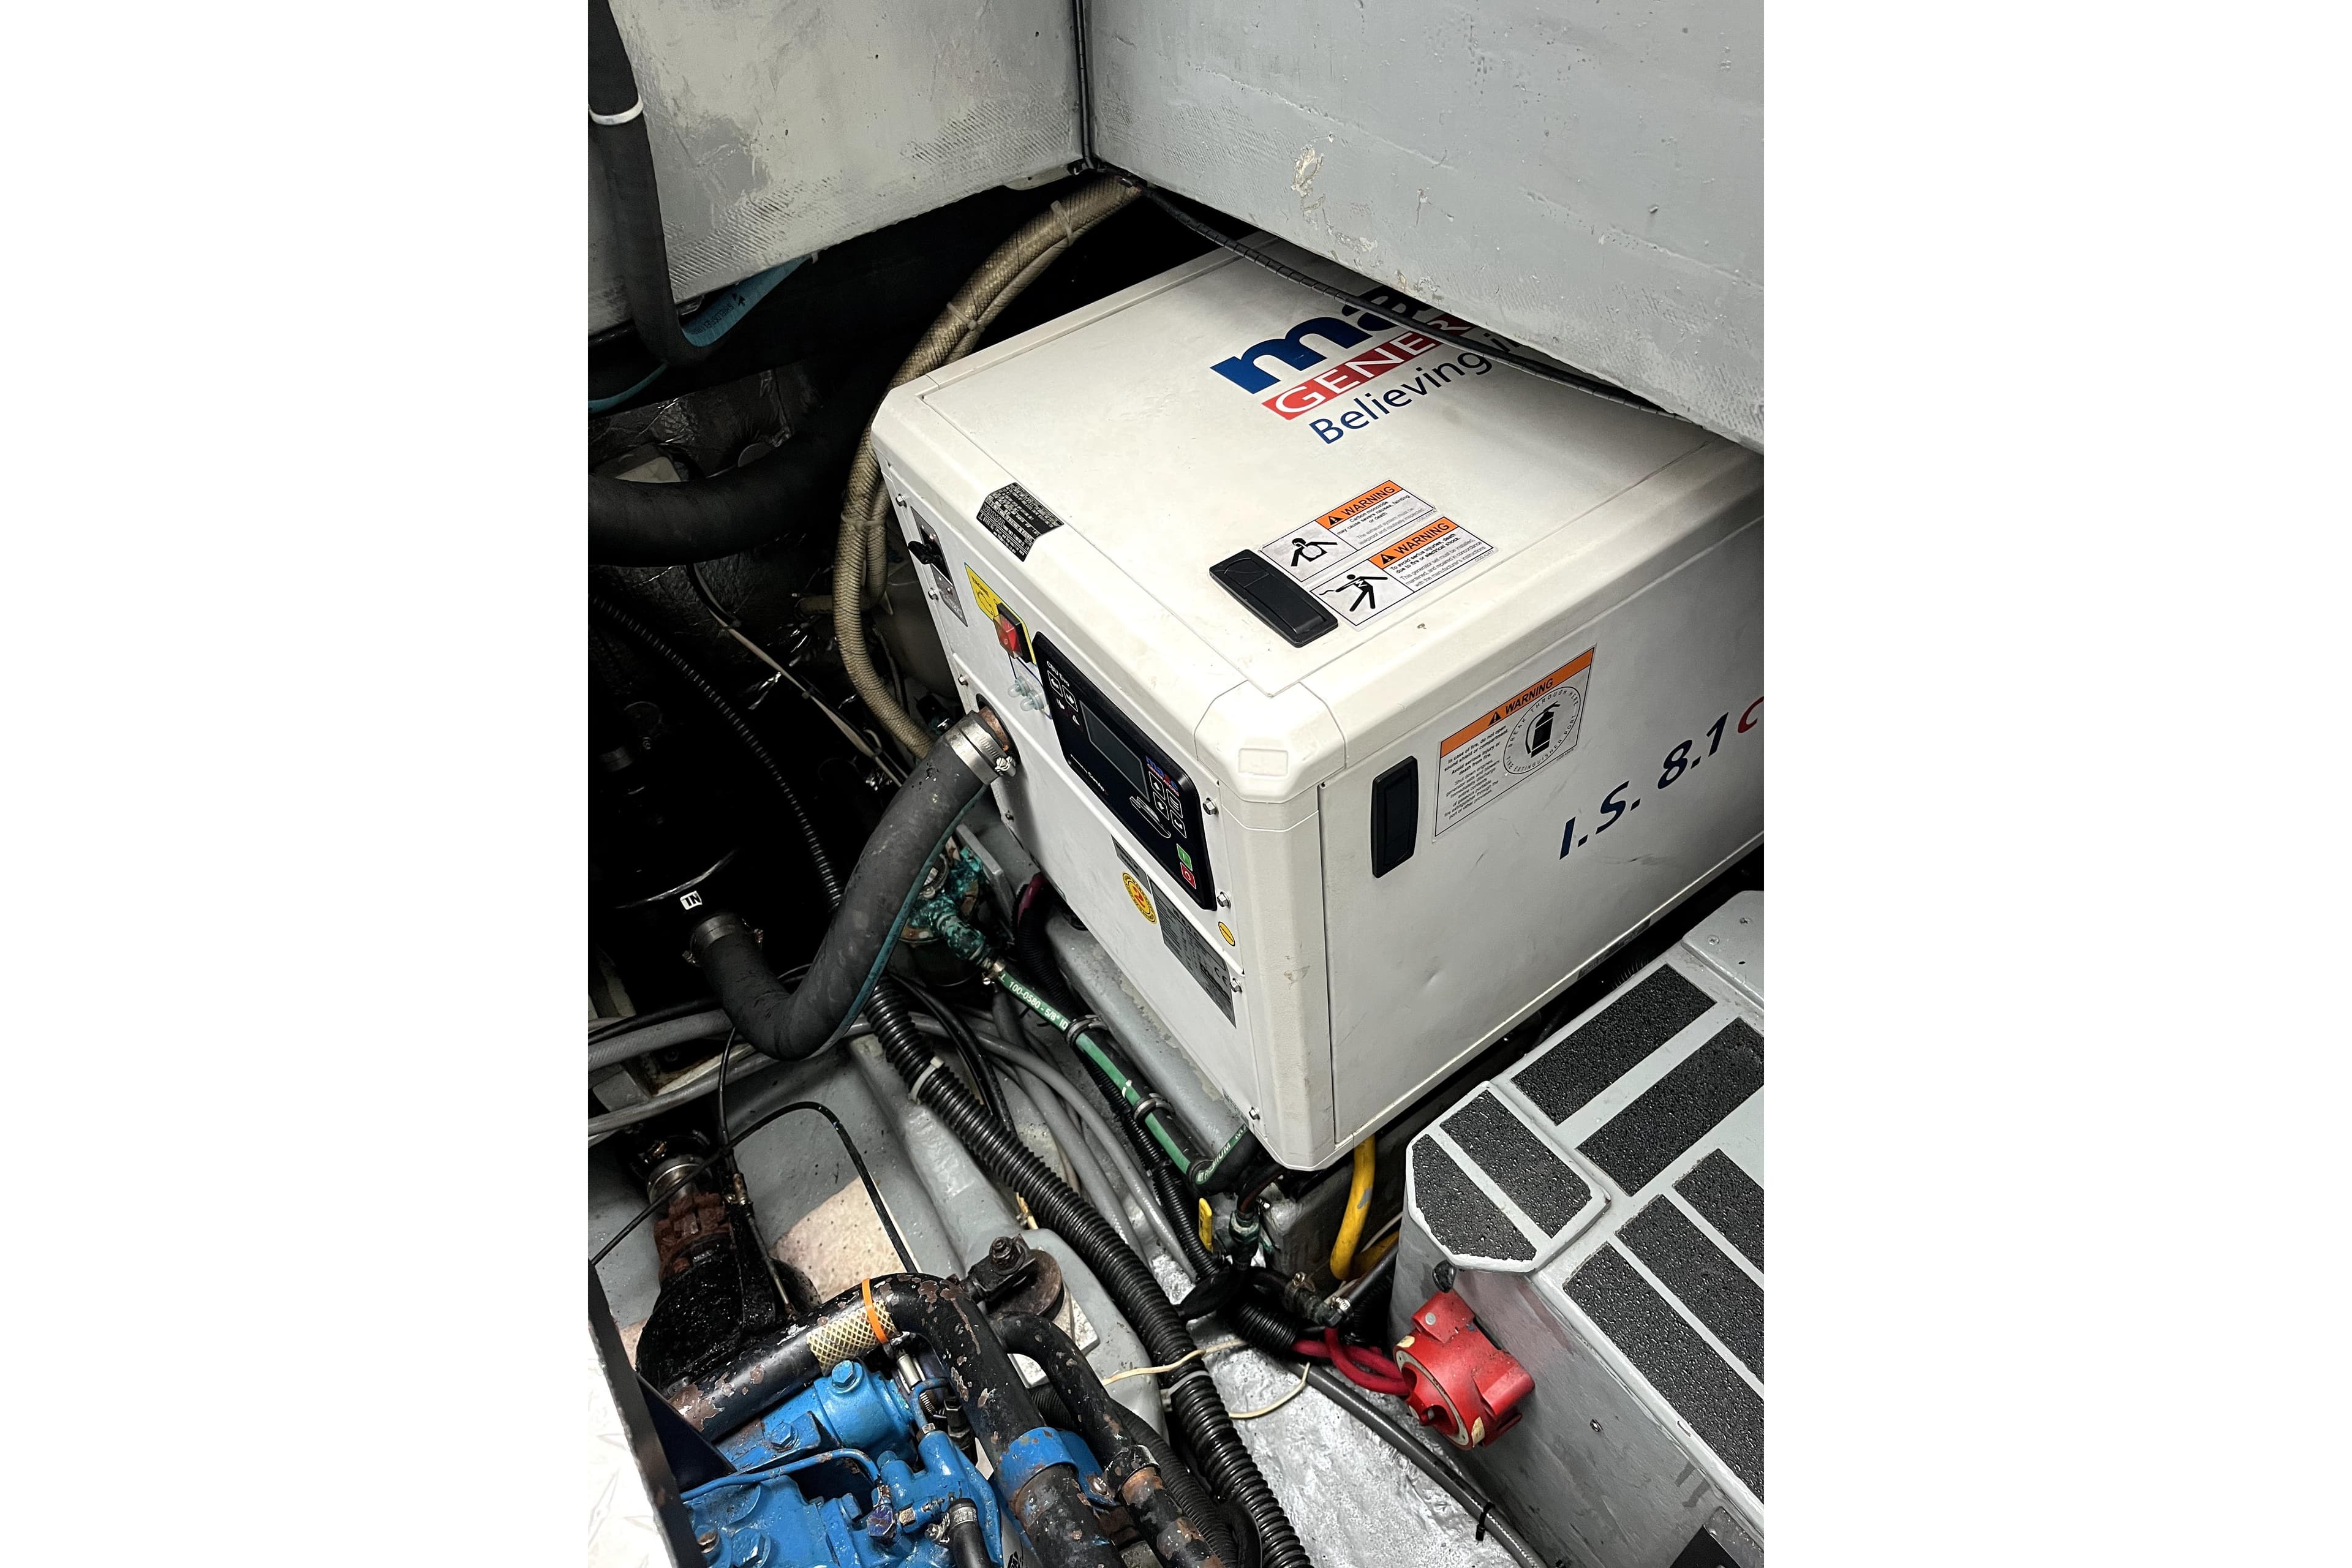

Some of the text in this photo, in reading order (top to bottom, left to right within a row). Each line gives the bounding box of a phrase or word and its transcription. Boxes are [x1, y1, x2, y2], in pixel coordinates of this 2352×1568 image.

[1309, 352, 1493, 445] Believing
[1341, 486, 1395, 516] WARNING
[1349, 501, 1388, 522] Carbon monoxide
[1394, 522, 1450, 554] WARNING
[1397, 558, 1411, 567] avoid
[1425, 545, 1446, 557] electrical
[1411, 562, 1432, 575] generator
[1047, 660, 1059, 676] CBU
[1505, 678, 1553, 714] WARNING
[1531, 690, 1567, 713] THROUGH
[1569, 691, 1578, 706] HERE
[1453, 752, 1464, 760] case
[1494, 725, 1506, 734] open
[1444, 760, 1458, 772] sound
[1458, 750, 1472, 762] shield
[1451, 764, 1464, 774] Avoid
[1482, 745, 1494, 755] injury
[1458, 765, 1471, 775] death
[1559, 780, 1641, 860] I.S.
[685, 893, 701, 907] IN
[1009, 981, 1041, 1009] 100-0580
[1059, 1019, 1069, 1030] ID
